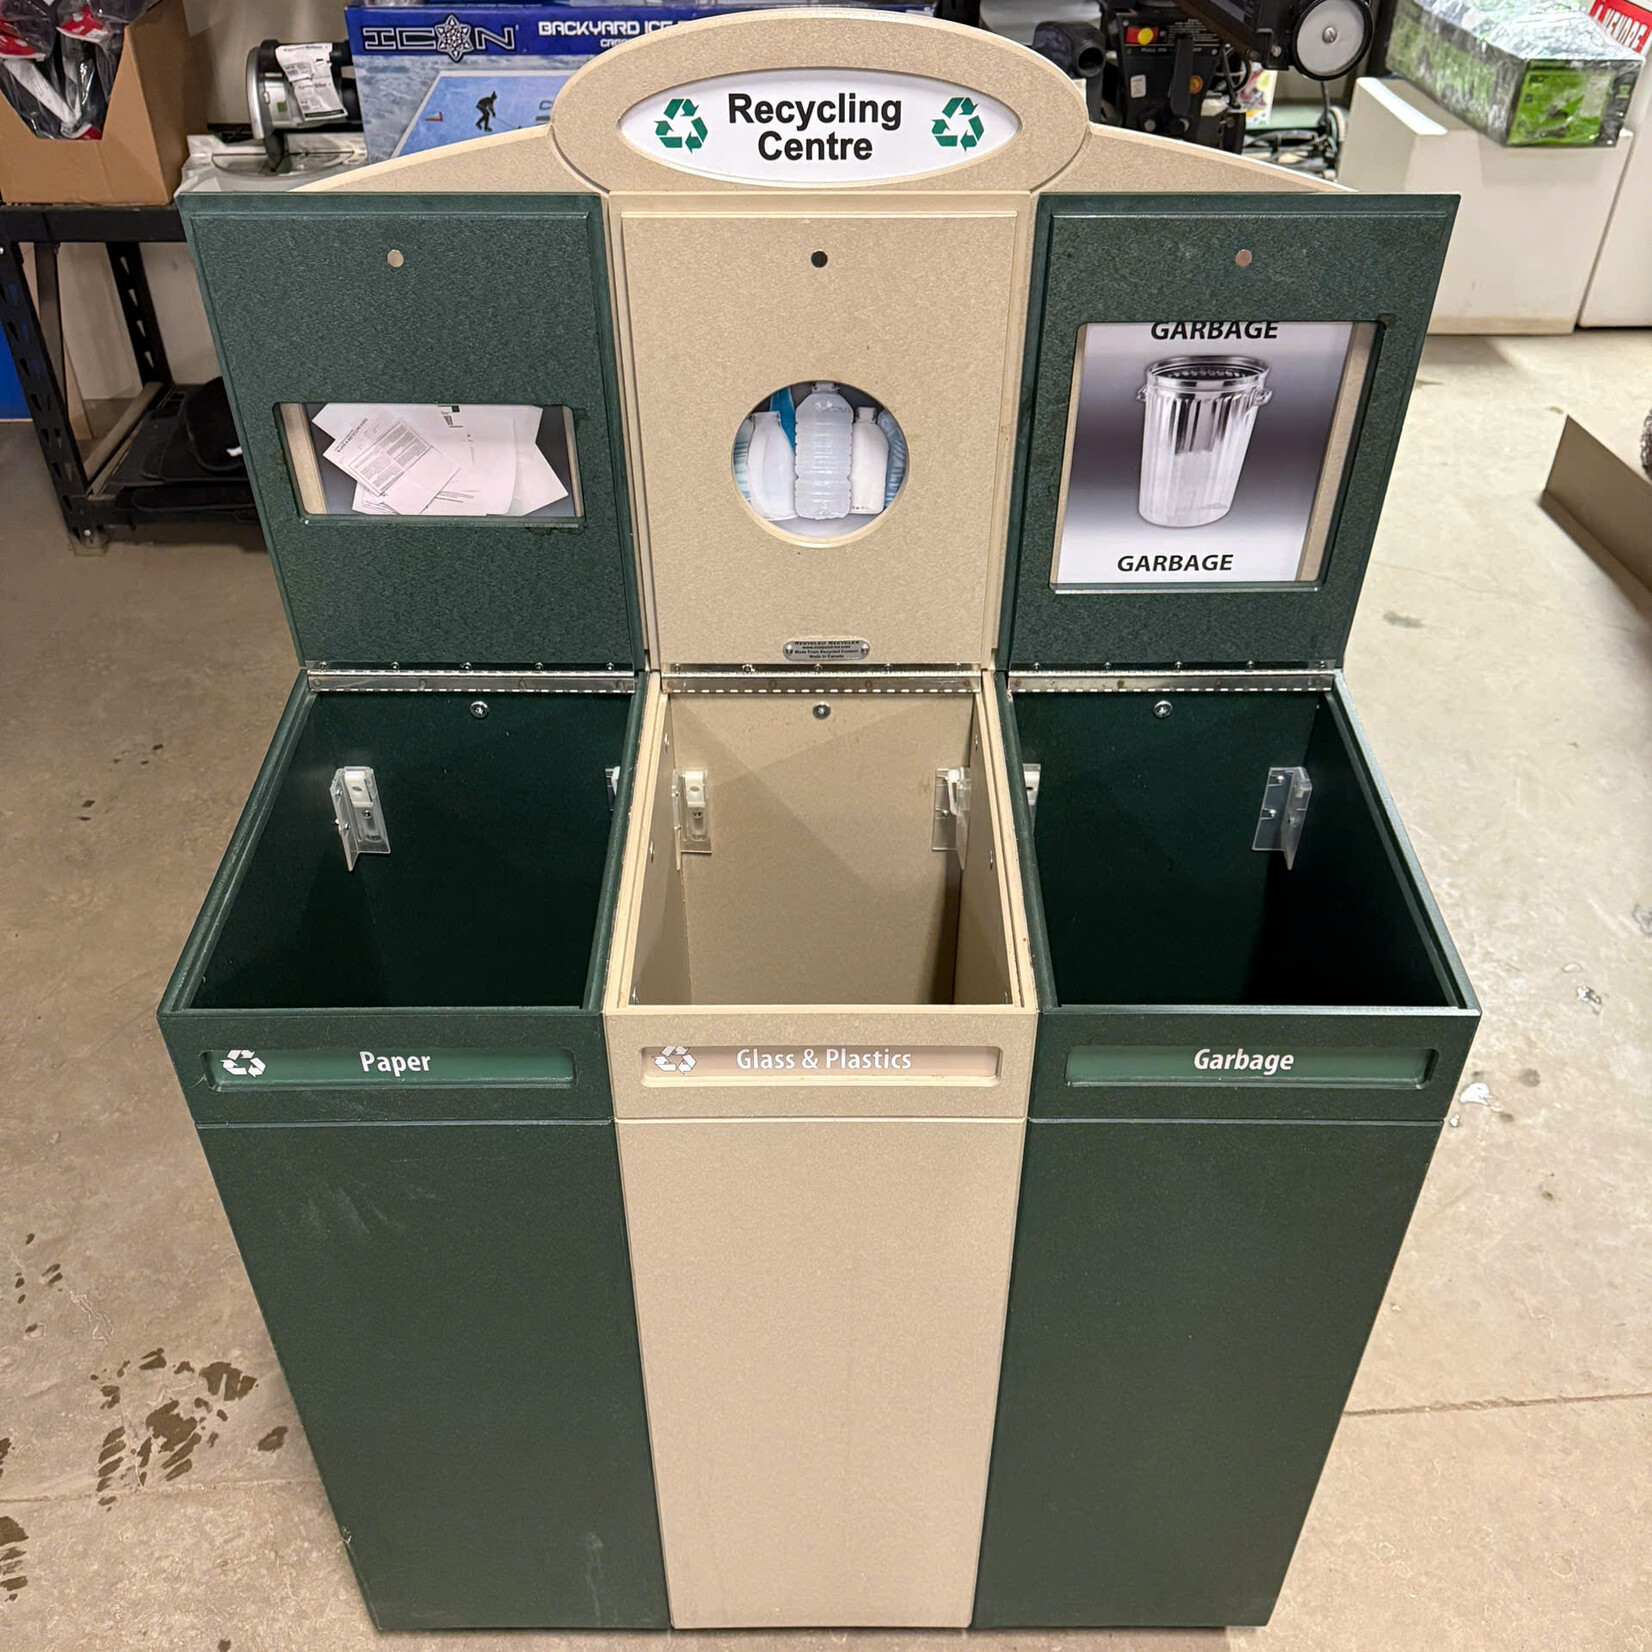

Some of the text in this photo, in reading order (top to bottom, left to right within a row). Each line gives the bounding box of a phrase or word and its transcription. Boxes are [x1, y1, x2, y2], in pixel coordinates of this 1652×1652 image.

[537, 20, 639, 36] BACKYARD
[728, 93, 901, 131] Recycling
[758, 130, 873, 161] Centre
[1150, 321, 1279, 340] GARBAGE
[1117, 554, 1234, 572] GARBAGE
[359, 1050, 431, 1077] Paper
[736, 1047, 912, 1070] Glass & Plastics
[1193, 1048, 1295, 1075] Garbage
